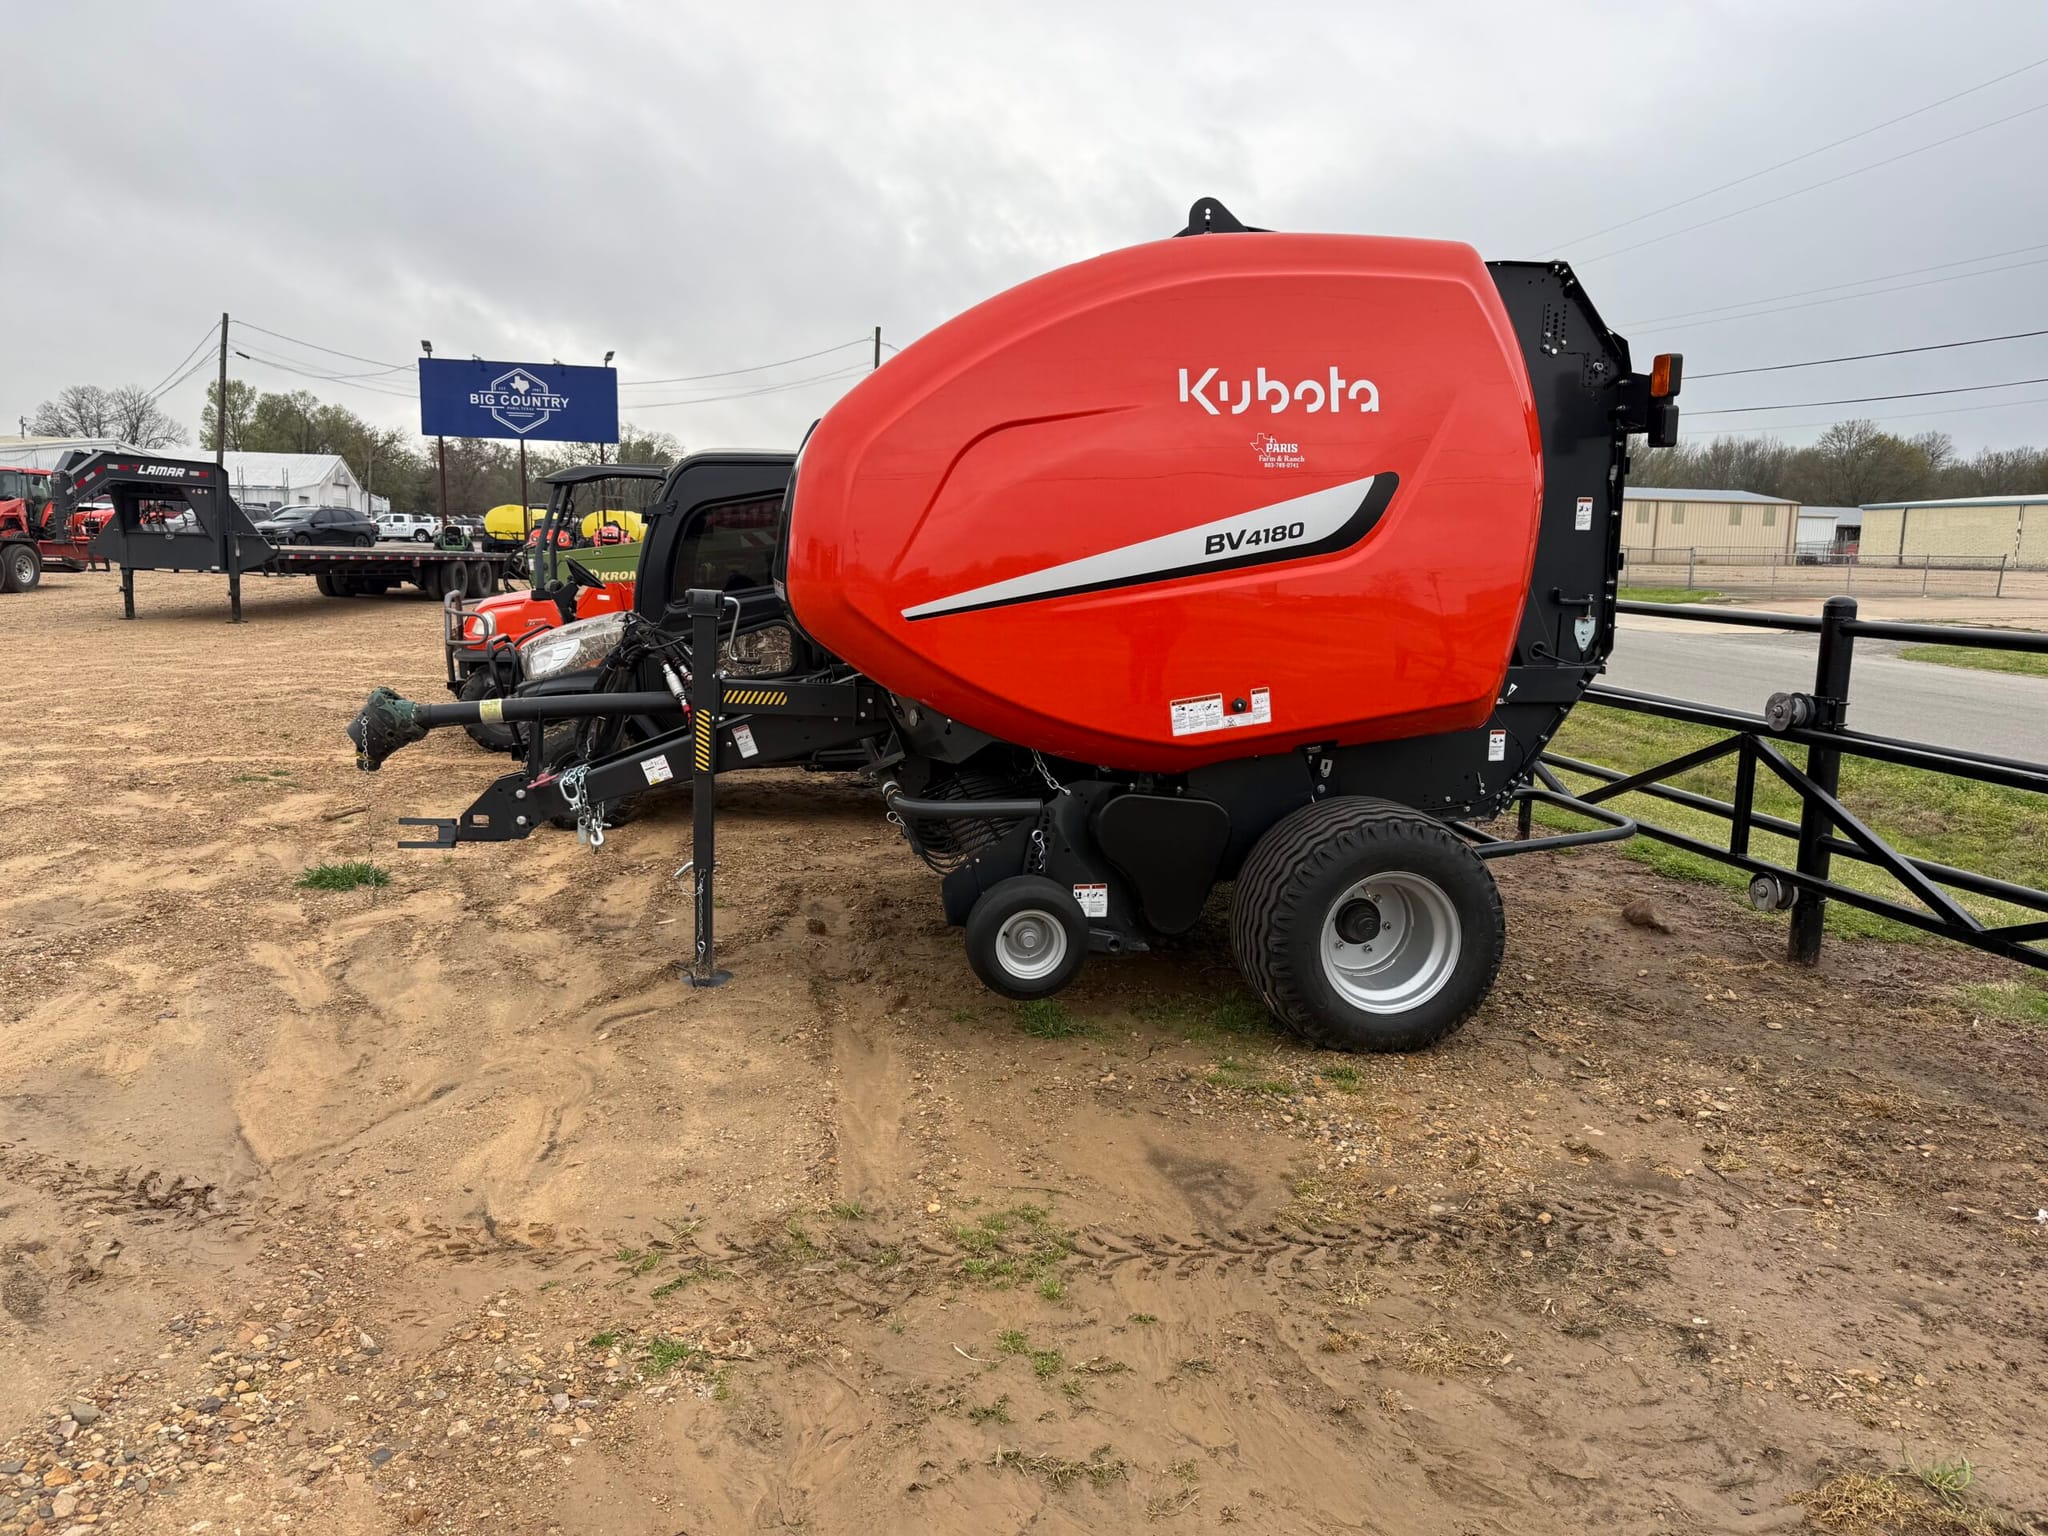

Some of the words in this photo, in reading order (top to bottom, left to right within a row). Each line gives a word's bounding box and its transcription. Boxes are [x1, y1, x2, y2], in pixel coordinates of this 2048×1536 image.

[1178, 366, 1380, 415] Kubota
[470, 393, 495, 405] BIG
[500, 395, 569, 409] COUNTRY
[1266, 443, 1298, 453] PARIS
[137, 464, 186, 478] LAMAR
[1205, 522, 1305, 555] BV4180
